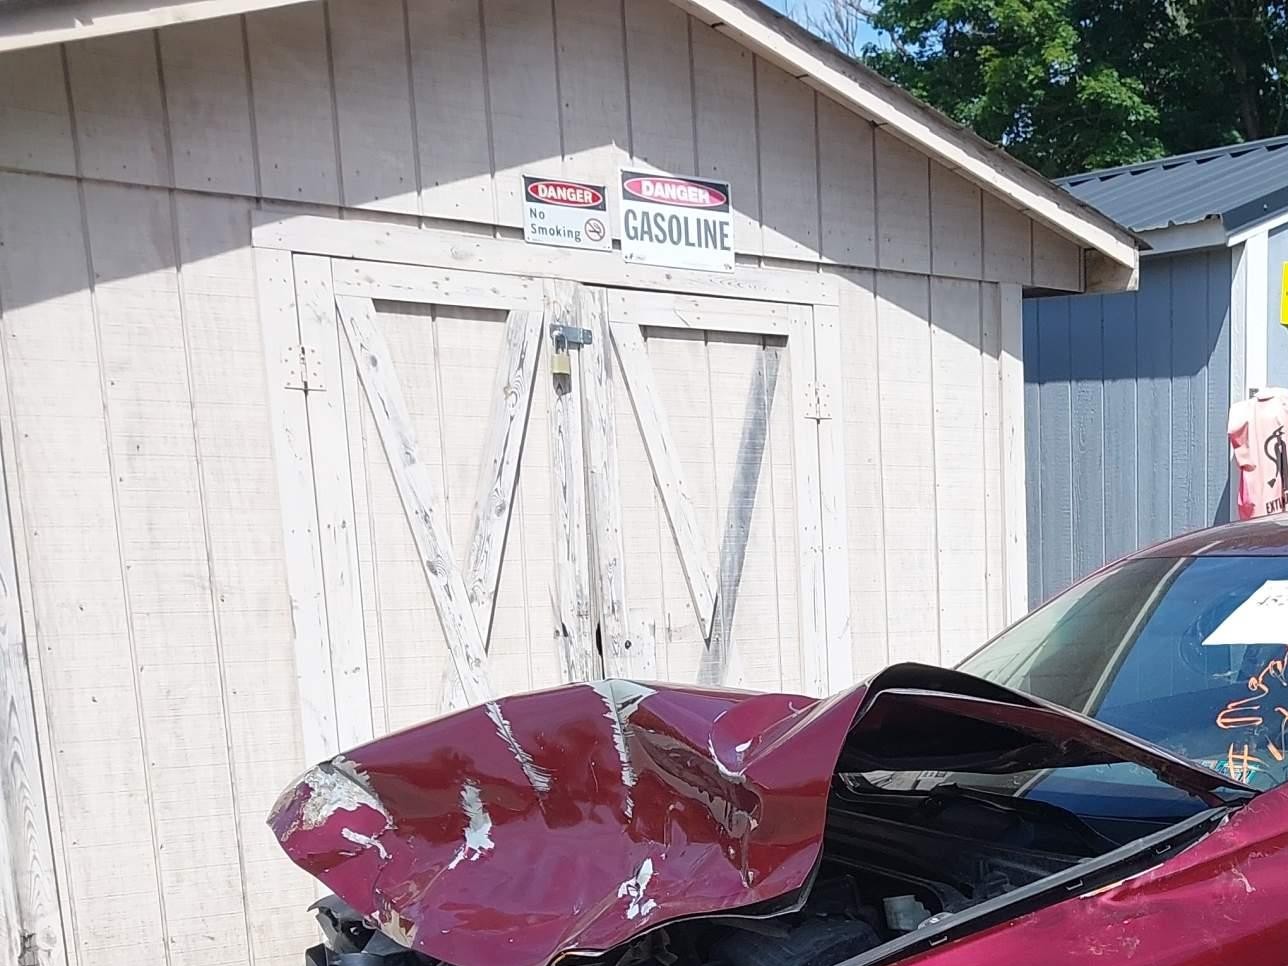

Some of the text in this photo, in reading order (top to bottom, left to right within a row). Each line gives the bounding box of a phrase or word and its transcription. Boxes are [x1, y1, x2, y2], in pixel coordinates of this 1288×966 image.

[537, 184, 594, 204] DANGER
[641, 180, 710, 204] DANGER
[529, 207, 546, 220] No
[530, 223, 582, 243] Smoking
[623, 208, 732, 251] GASOLINE
